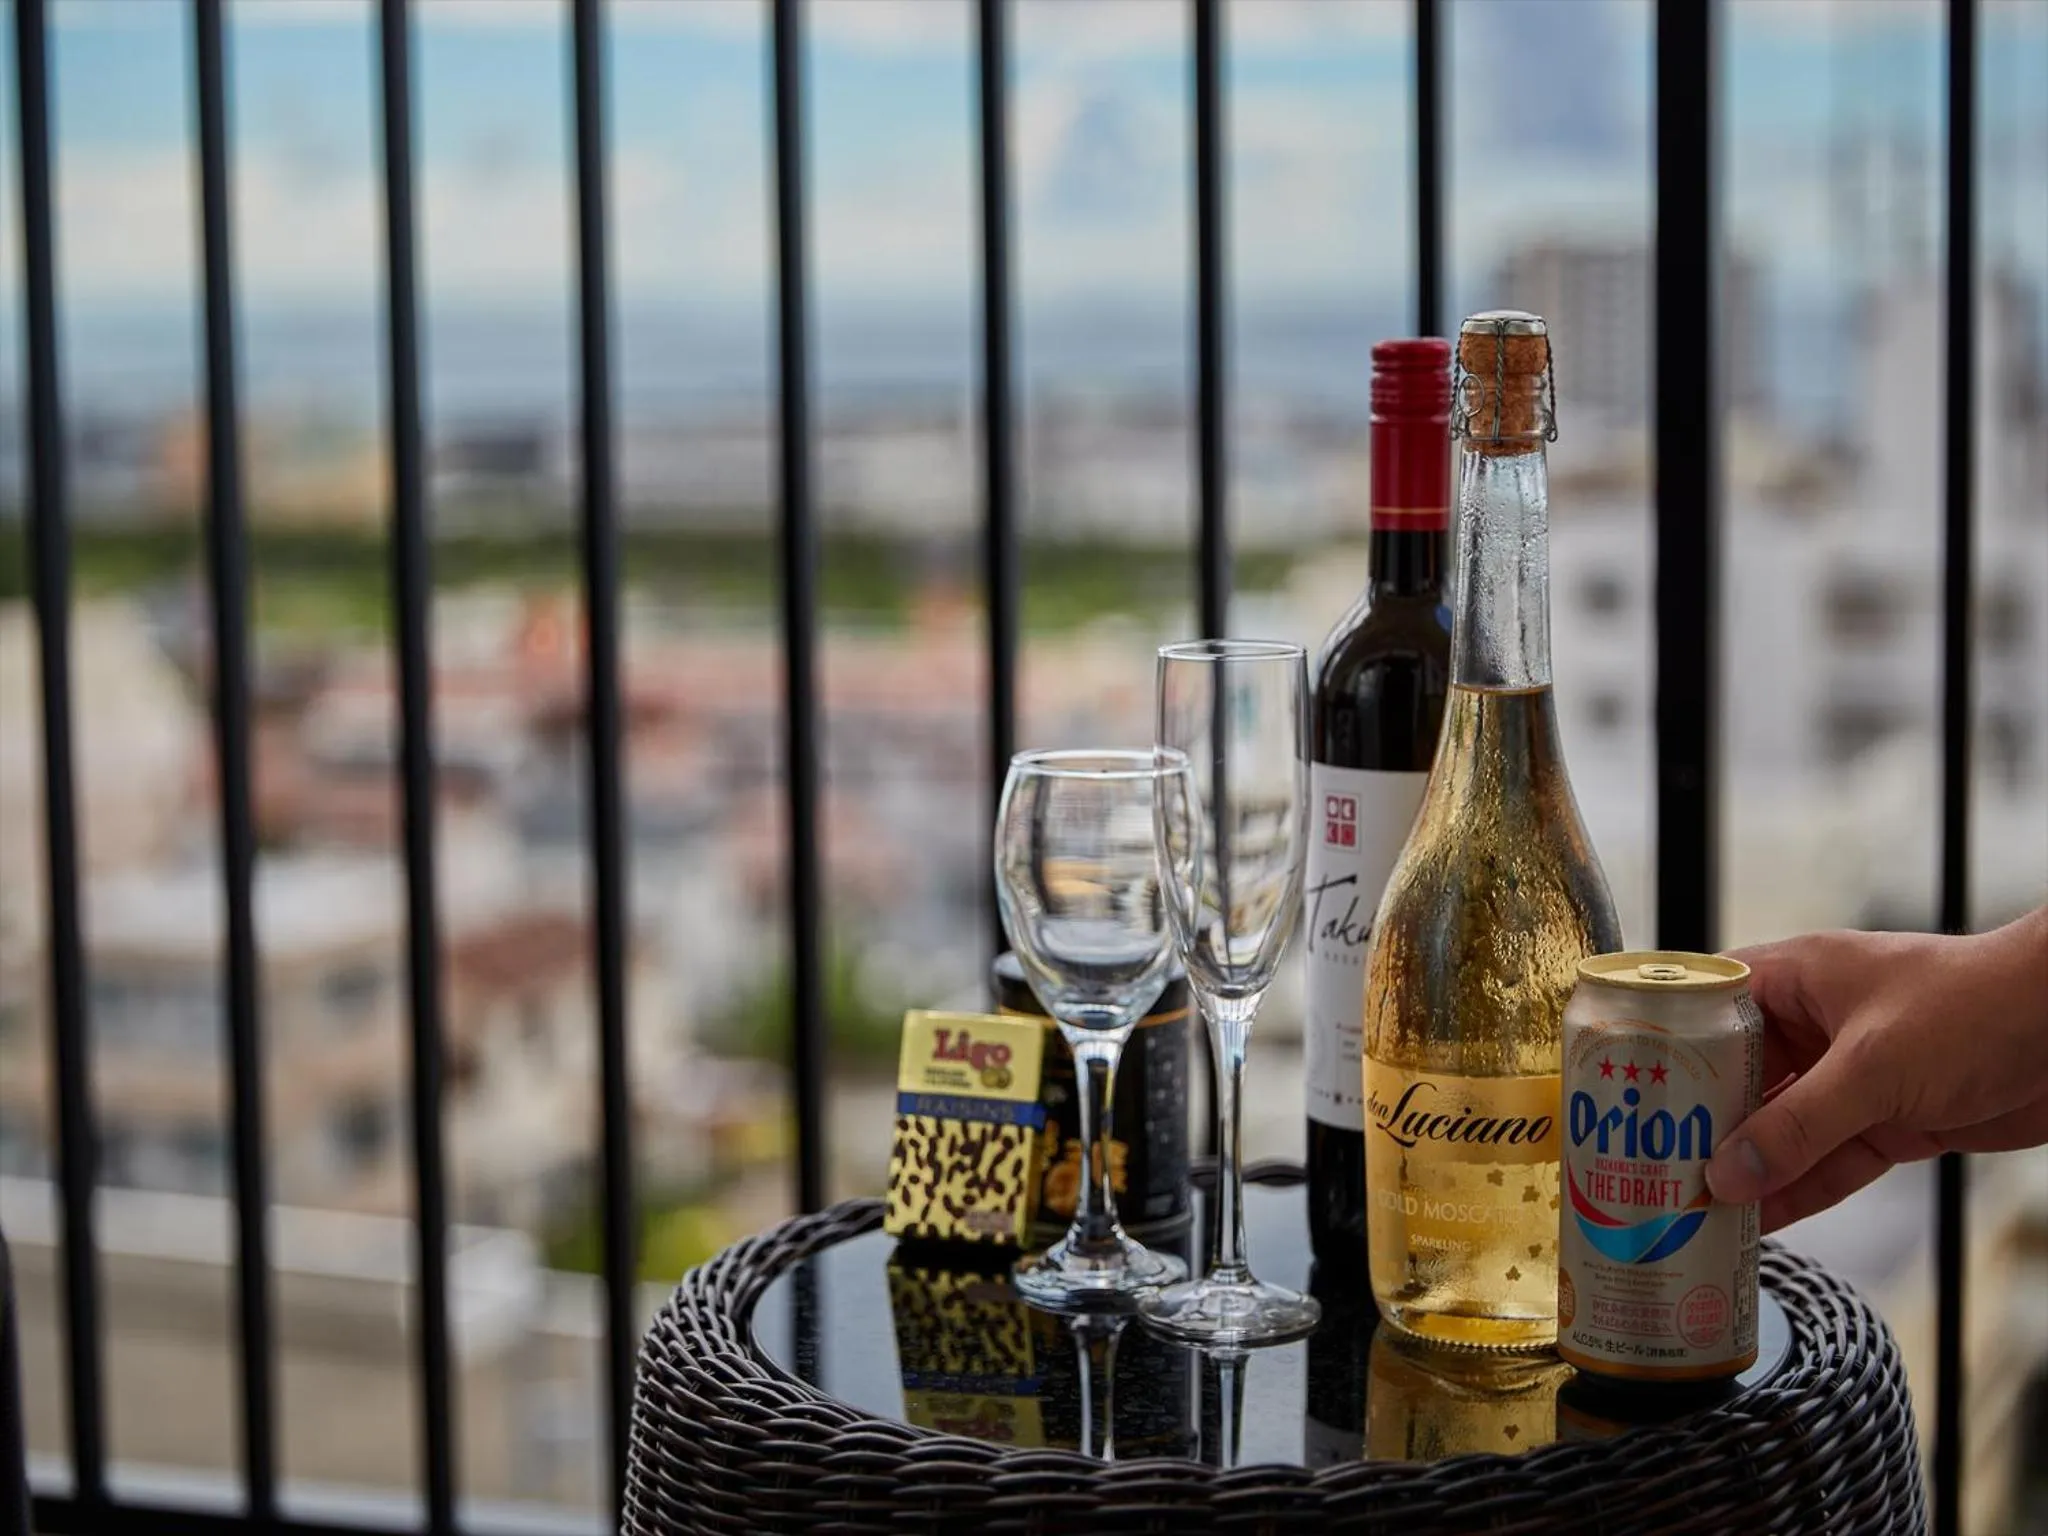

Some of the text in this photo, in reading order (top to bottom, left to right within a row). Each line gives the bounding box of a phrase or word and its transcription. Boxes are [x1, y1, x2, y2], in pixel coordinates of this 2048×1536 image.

[932, 1026, 1012, 1071] Ligo
[1376, 1082, 1553, 1148] Luciano
[1570, 1088, 1712, 1160] Orion
[1584, 1169, 1683, 1208] THE DRAFT
